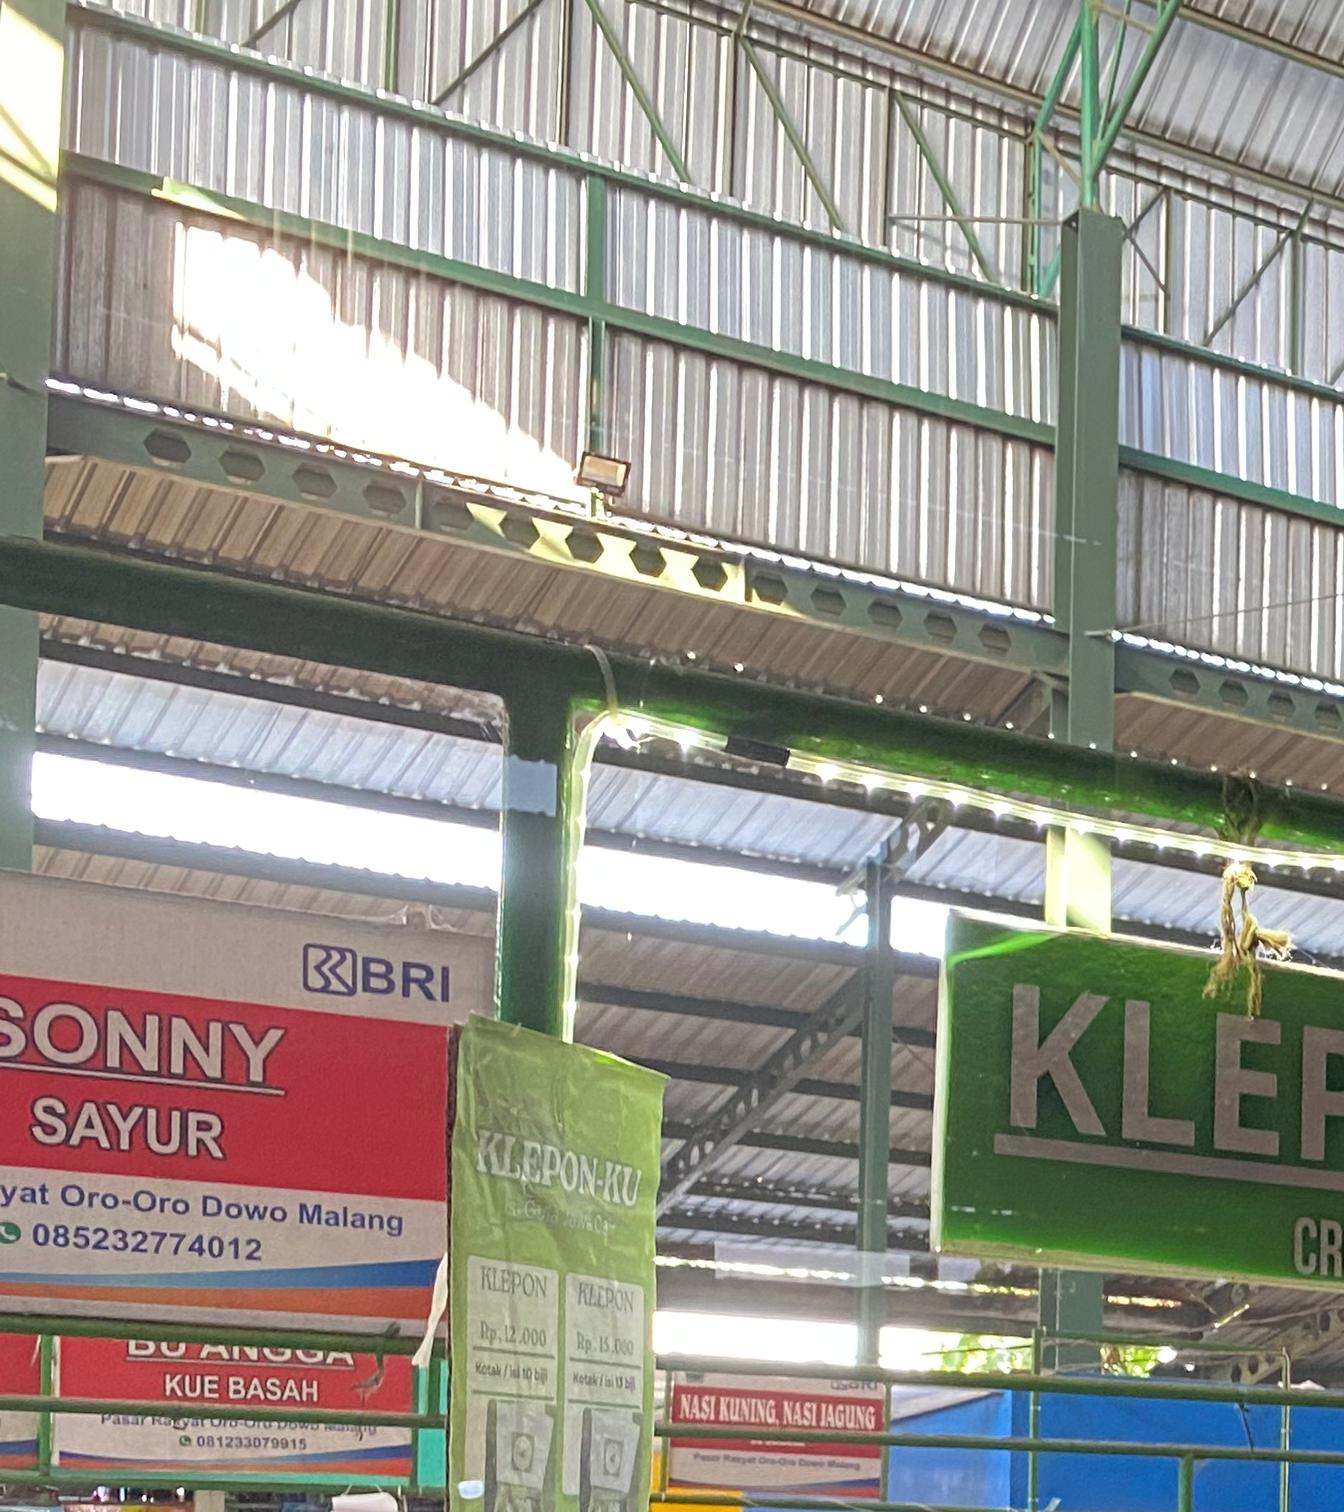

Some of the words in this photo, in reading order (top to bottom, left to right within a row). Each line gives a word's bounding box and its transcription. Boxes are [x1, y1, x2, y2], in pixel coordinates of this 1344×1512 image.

[361, 957, 450, 1003] BRI
[30, 1095, 225, 1160] SAYUR
[476, 1129, 642, 1207] KLEPON-KU
[60, 1183, 190, 1216] Oro-Oro
[201, 1195, 288, 1222] Dowo
[298, 1203, 404, 1236] Malang
[31, 1223, 263, 1261] 085232774012
[480, 1265, 548, 1297] KLEPON
[577, 1281, 635, 1312] KLEPON
[164, 1374, 219, 1399] KUE
[228, 1376, 319, 1402] BASAH
[678, 1393, 716, 1421] NASI
[718, 1396, 780, 1425] KUNING,
[782, 1400, 818, 1427] NASI
[819, 1402, 876, 1430] JAGUNG
[196, 1435, 307, 1450] 081233079915
